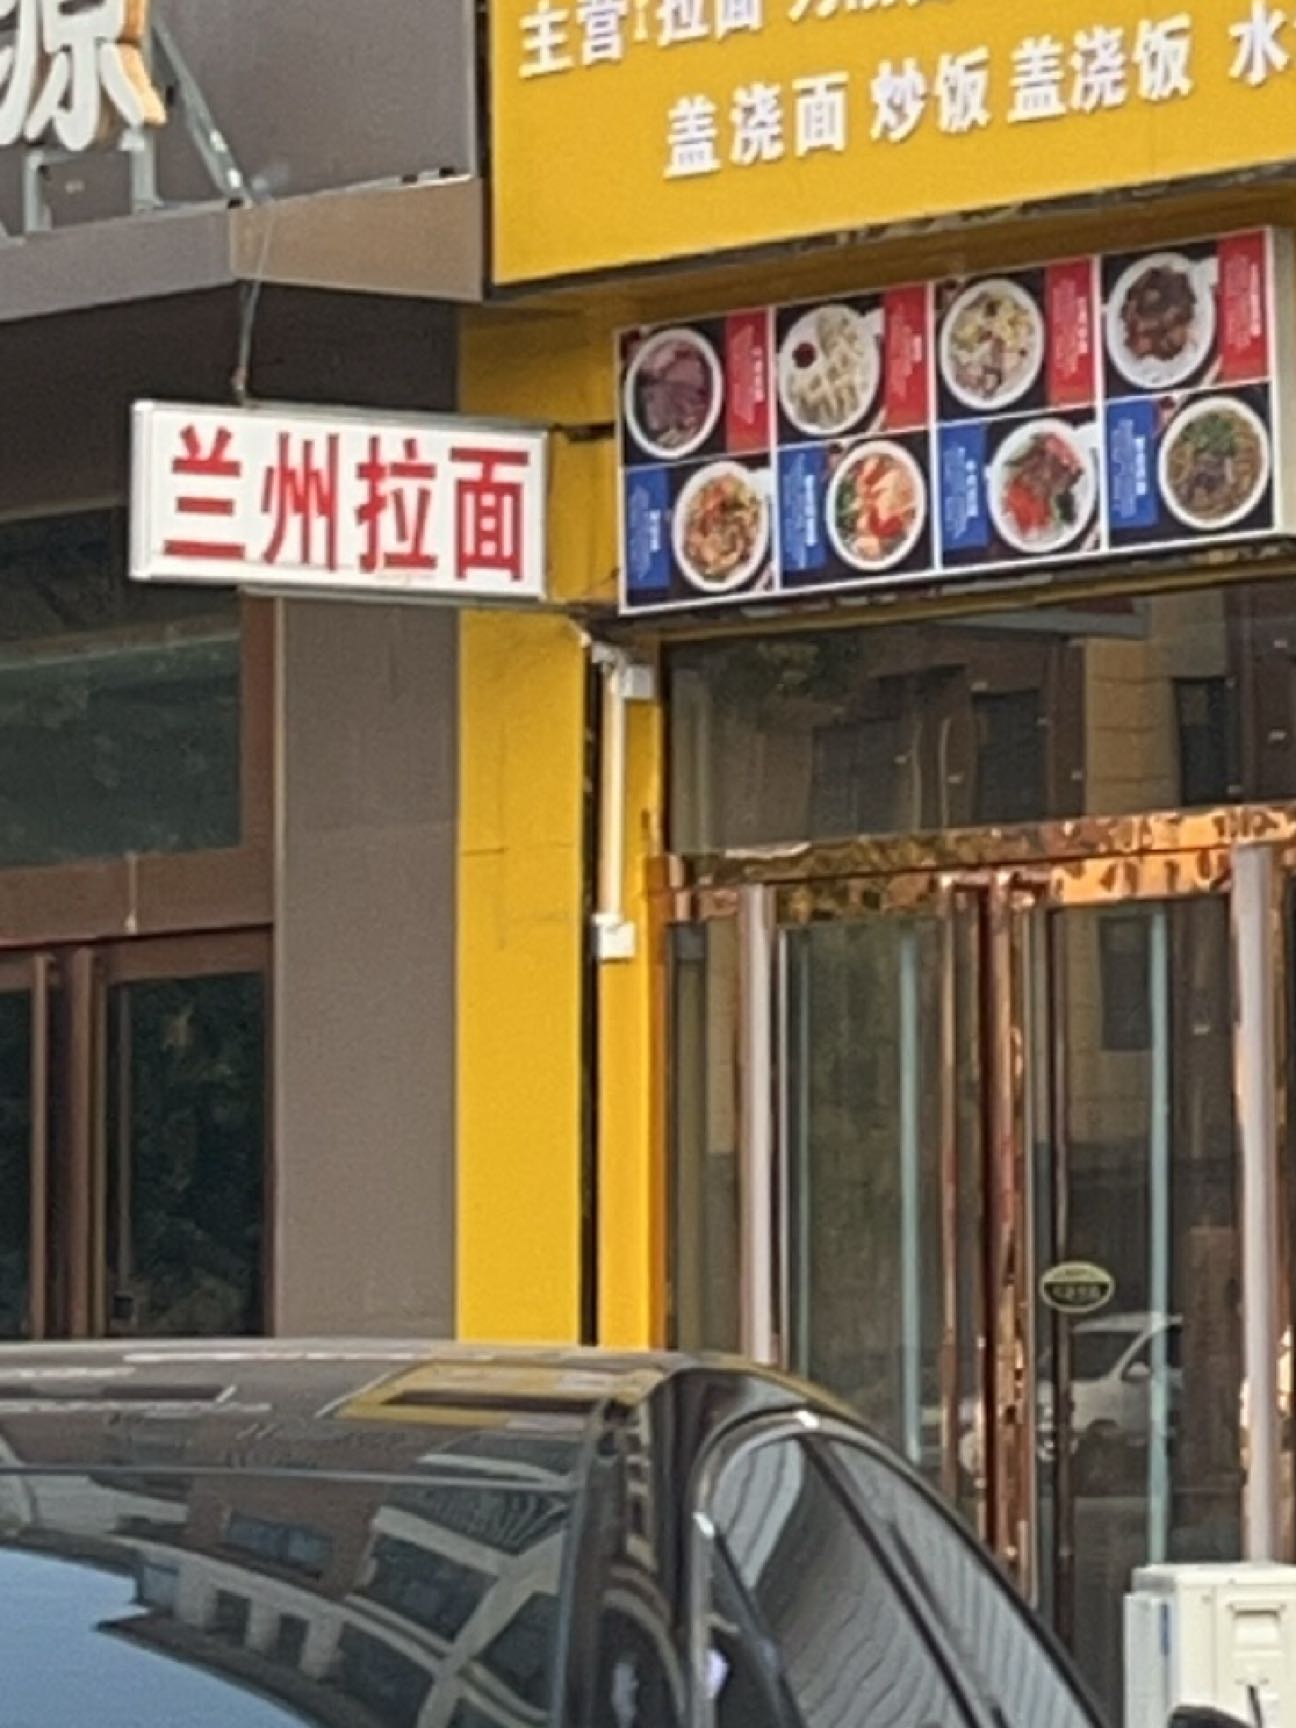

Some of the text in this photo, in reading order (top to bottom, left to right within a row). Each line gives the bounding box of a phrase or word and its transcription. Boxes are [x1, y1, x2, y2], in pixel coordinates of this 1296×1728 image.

[663, 71, 849, 180] 盖浇面
[869, 44, 991, 142] 炒饭
[1007, 12, 1195, 123] 盖浇饭
[163, 423, 530, 583] 兰州拉面
